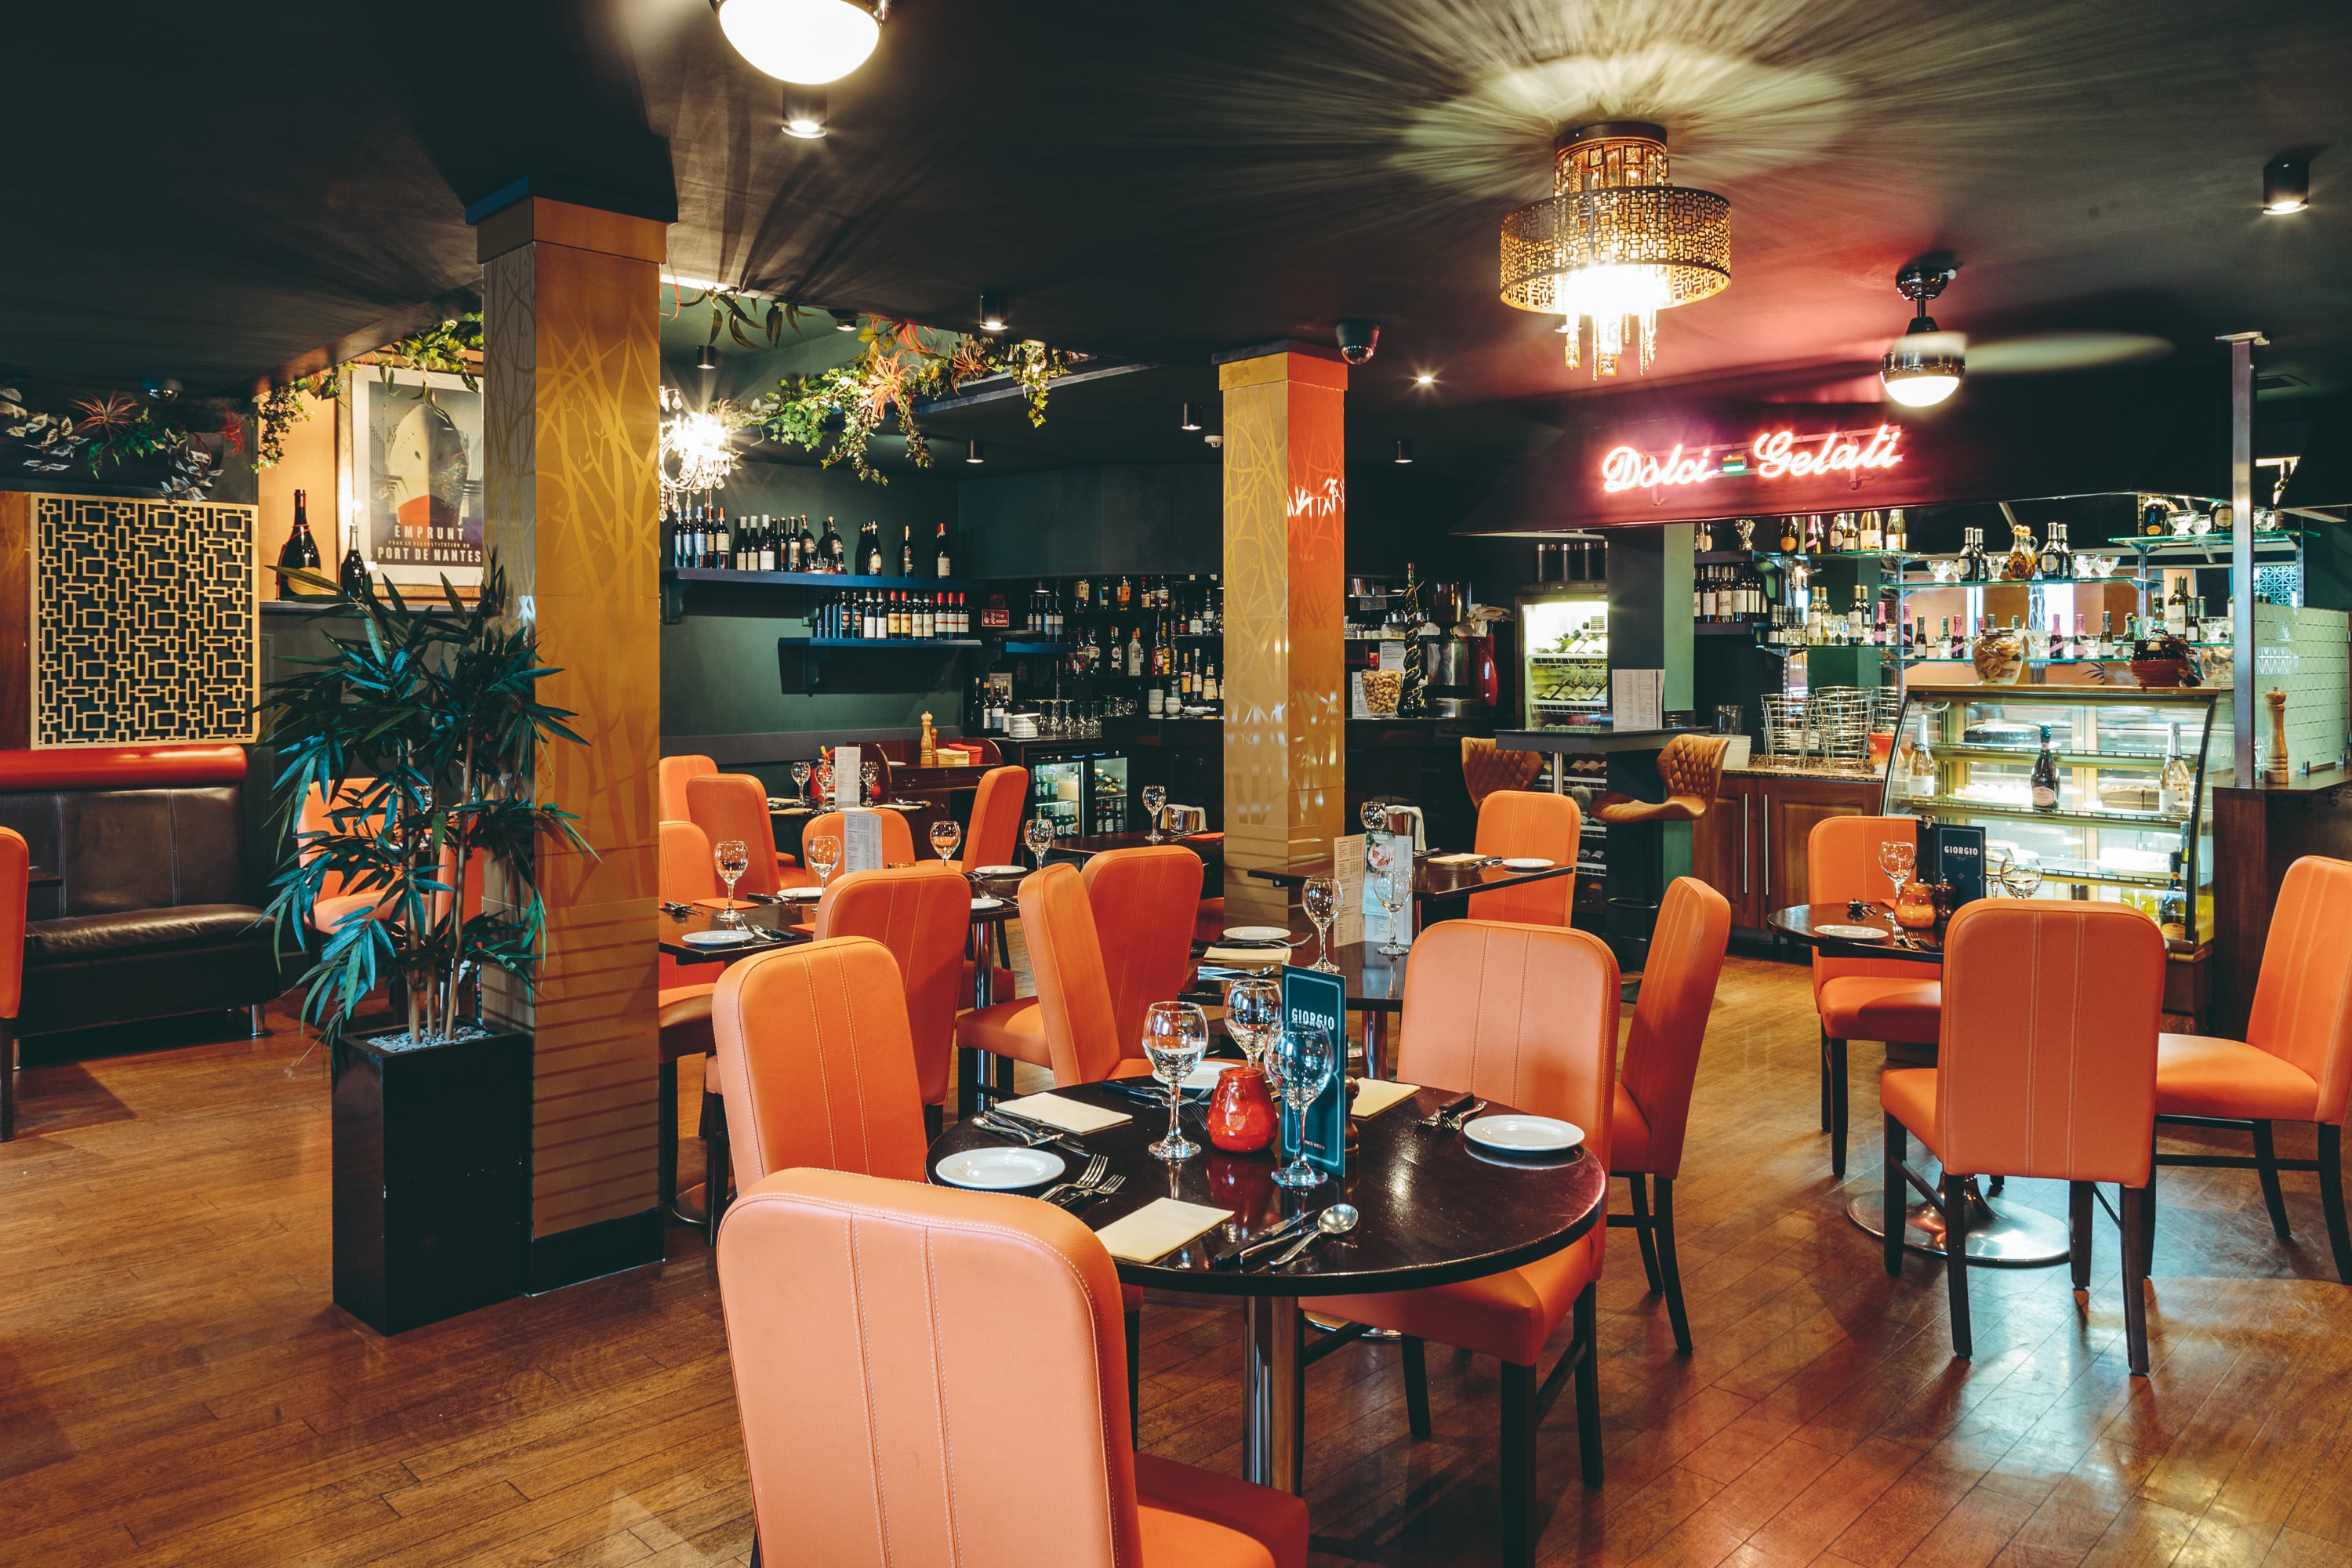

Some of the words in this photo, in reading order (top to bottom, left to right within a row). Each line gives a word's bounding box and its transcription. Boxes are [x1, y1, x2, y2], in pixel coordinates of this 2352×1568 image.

[1602, 444, 1716, 493] Dolci
[1753, 424, 1901, 478] Gelati
[394, 524, 464, 541] EMPRUNT
[377, 546, 409, 560] PORT
[415, 548, 429, 561] DE
[434, 549, 481, 563] NANTES
[1944, 845, 1978, 855] GIORGIO
[1291, 1007, 1334, 1030] GIORGIO
